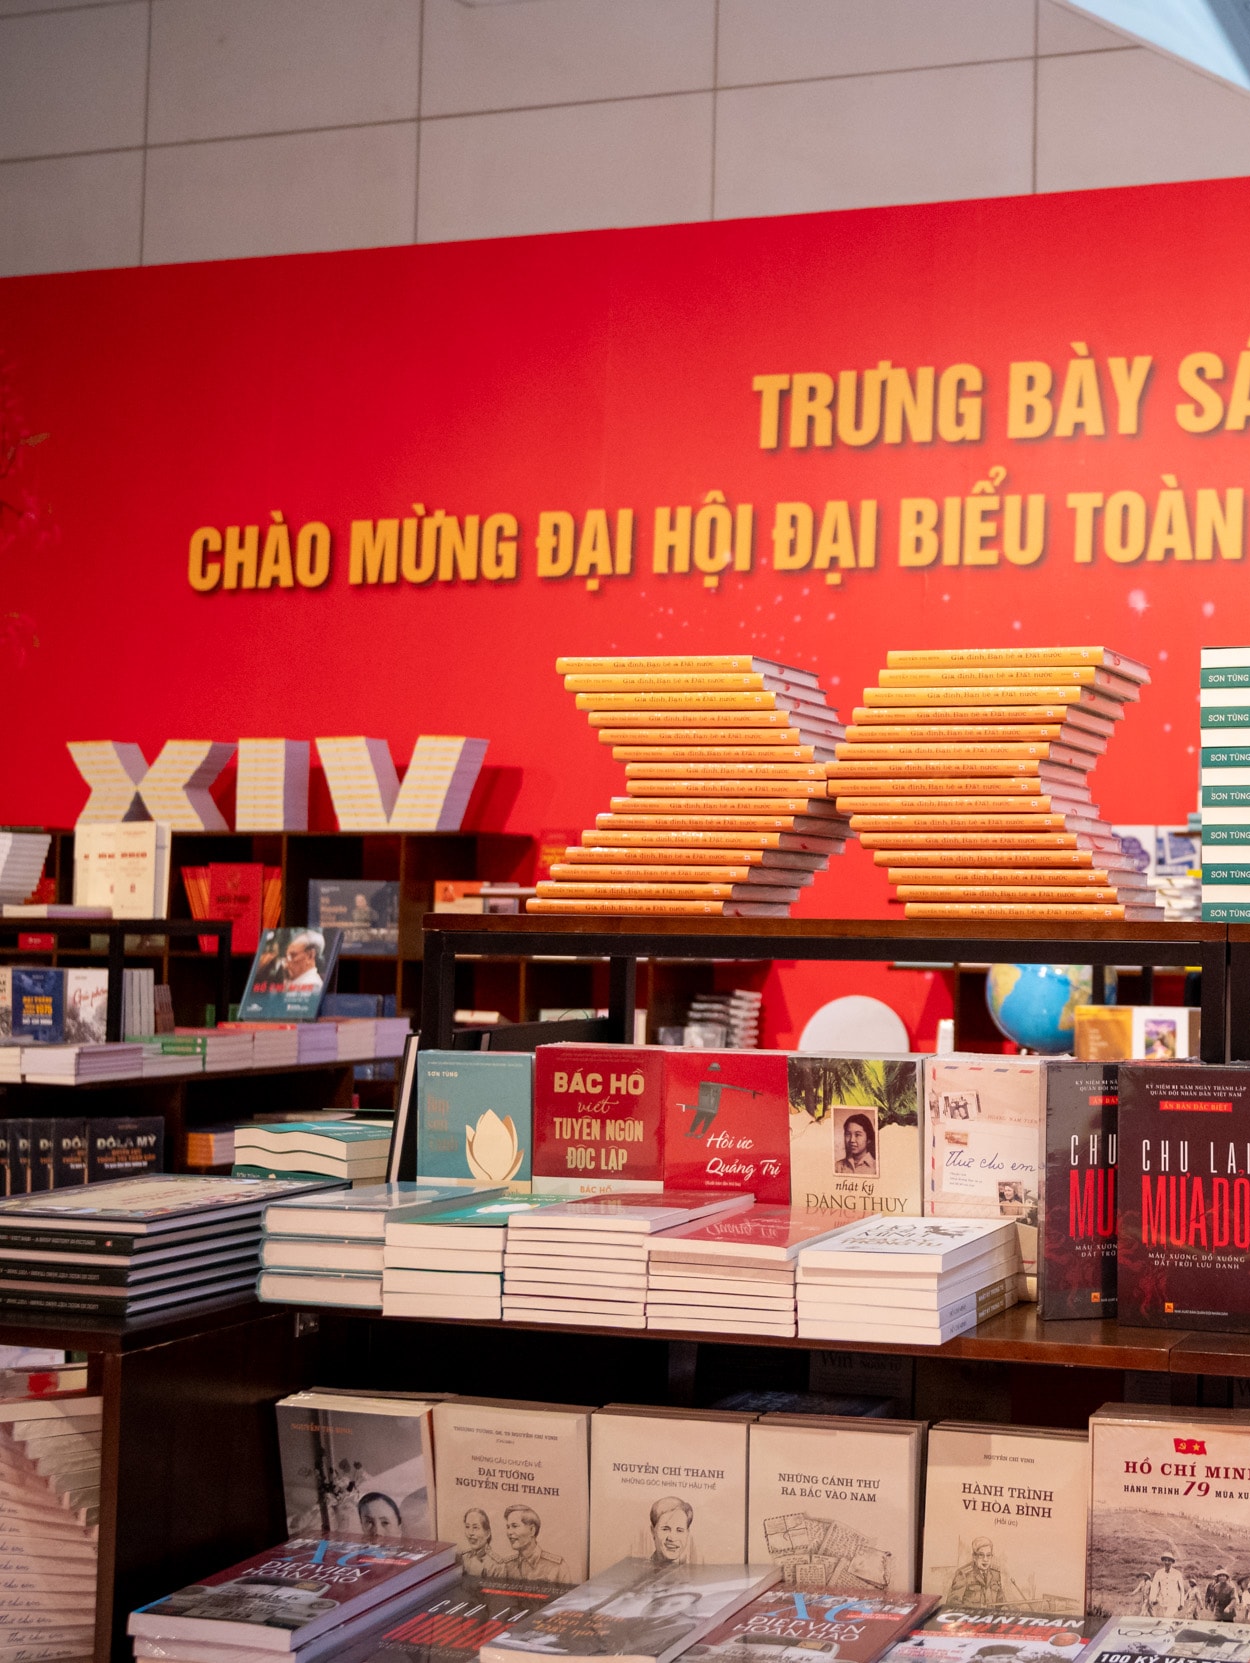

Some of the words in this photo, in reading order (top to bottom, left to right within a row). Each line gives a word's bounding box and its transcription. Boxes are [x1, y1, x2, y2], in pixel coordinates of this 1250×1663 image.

[752, 361, 983, 451] TRƯNG
[1007, 342, 1152, 438] BÀY
[187, 511, 331, 592] CHÀO
[349, 505, 517, 585] MỪNG
[536, 508, 633, 591] ĐẠI
[652, 492, 752, 588] HỘI
[772, 498, 878, 585] ĐẠI
[899, 466, 1045, 567] BIỂU
[1067, 475, 1244, 563] TOÀN
[1209, 674, 1225, 682] SƠN
[1227, 674, 1249, 682] TÙNG
[554, 1068, 603, 1094] BÁC
[610, 1068, 644, 1095] HỒ
[578, 1096, 619, 1114] viết
[553, 1115, 600, 1140] TUYÊN
[606, 1117, 643, 1142] NGÔN
[706, 1130, 735, 1150] Hồi
[737, 1139, 754, 1150] ức
[566, 1144, 595, 1171] ĐỘC
[601, 1145, 627, 1173] LẬP
[980, 1153, 1004, 1169] cho
[1011, 1163, 1036, 1171] em
[1142, 1140, 1188, 1172] CHU
[1210, 1142, 1250, 1174] LAI
[706, 1158, 756, 1181] Quảng
[760, 1159, 781, 1177] Trị
[861, 1181, 874, 1196] ký
[1142, 1172, 1207, 1250] MƯA
[1212, 1170, 1250, 1253] ĐỎ
[499, 1468, 535, 1481] TƯỚNG
[612, 1462, 659, 1475] NGUYỄN
[662, 1465, 682, 1476] CHÍ
[683, 1468, 725, 1479] THANH
[1124, 1456, 1152, 1475] HỒ
[1160, 1460, 1197, 1478] CHÍ
[455, 1477, 498, 1490] NGUYỄN
[501, 1481, 519, 1492] CHÍ
[522, 1483, 560, 1497] THANH
[778, 1471, 819, 1485] NHỮNG
[821, 1475, 853, 1488] CÁNH
[856, 1478, 881, 1489] THƯ
[1124, 1482, 1148, 1494] HÀNH
[1152, 1485, 1180, 1496] TRÌNH
[1182, 1480, 1210, 1498] 79
[1215, 1488, 1235, 1500] MÙA
[781, 1486, 796, 1496] RA
[799, 1486, 822, 1498] BẮC
[824, 1488, 848, 1500] VÀO
[850, 1492, 877, 1503] NAM
[962, 1481, 1004, 1497] HÀNH
[1008, 1484, 1054, 1502] TRÌNH
[962, 1499, 978, 1511] VÌ
[980, 1501, 1012, 1515] HÒA
[1015, 1504, 1052, 1518] BÌNH
[1100, 1653, 1132, 1663] 100
